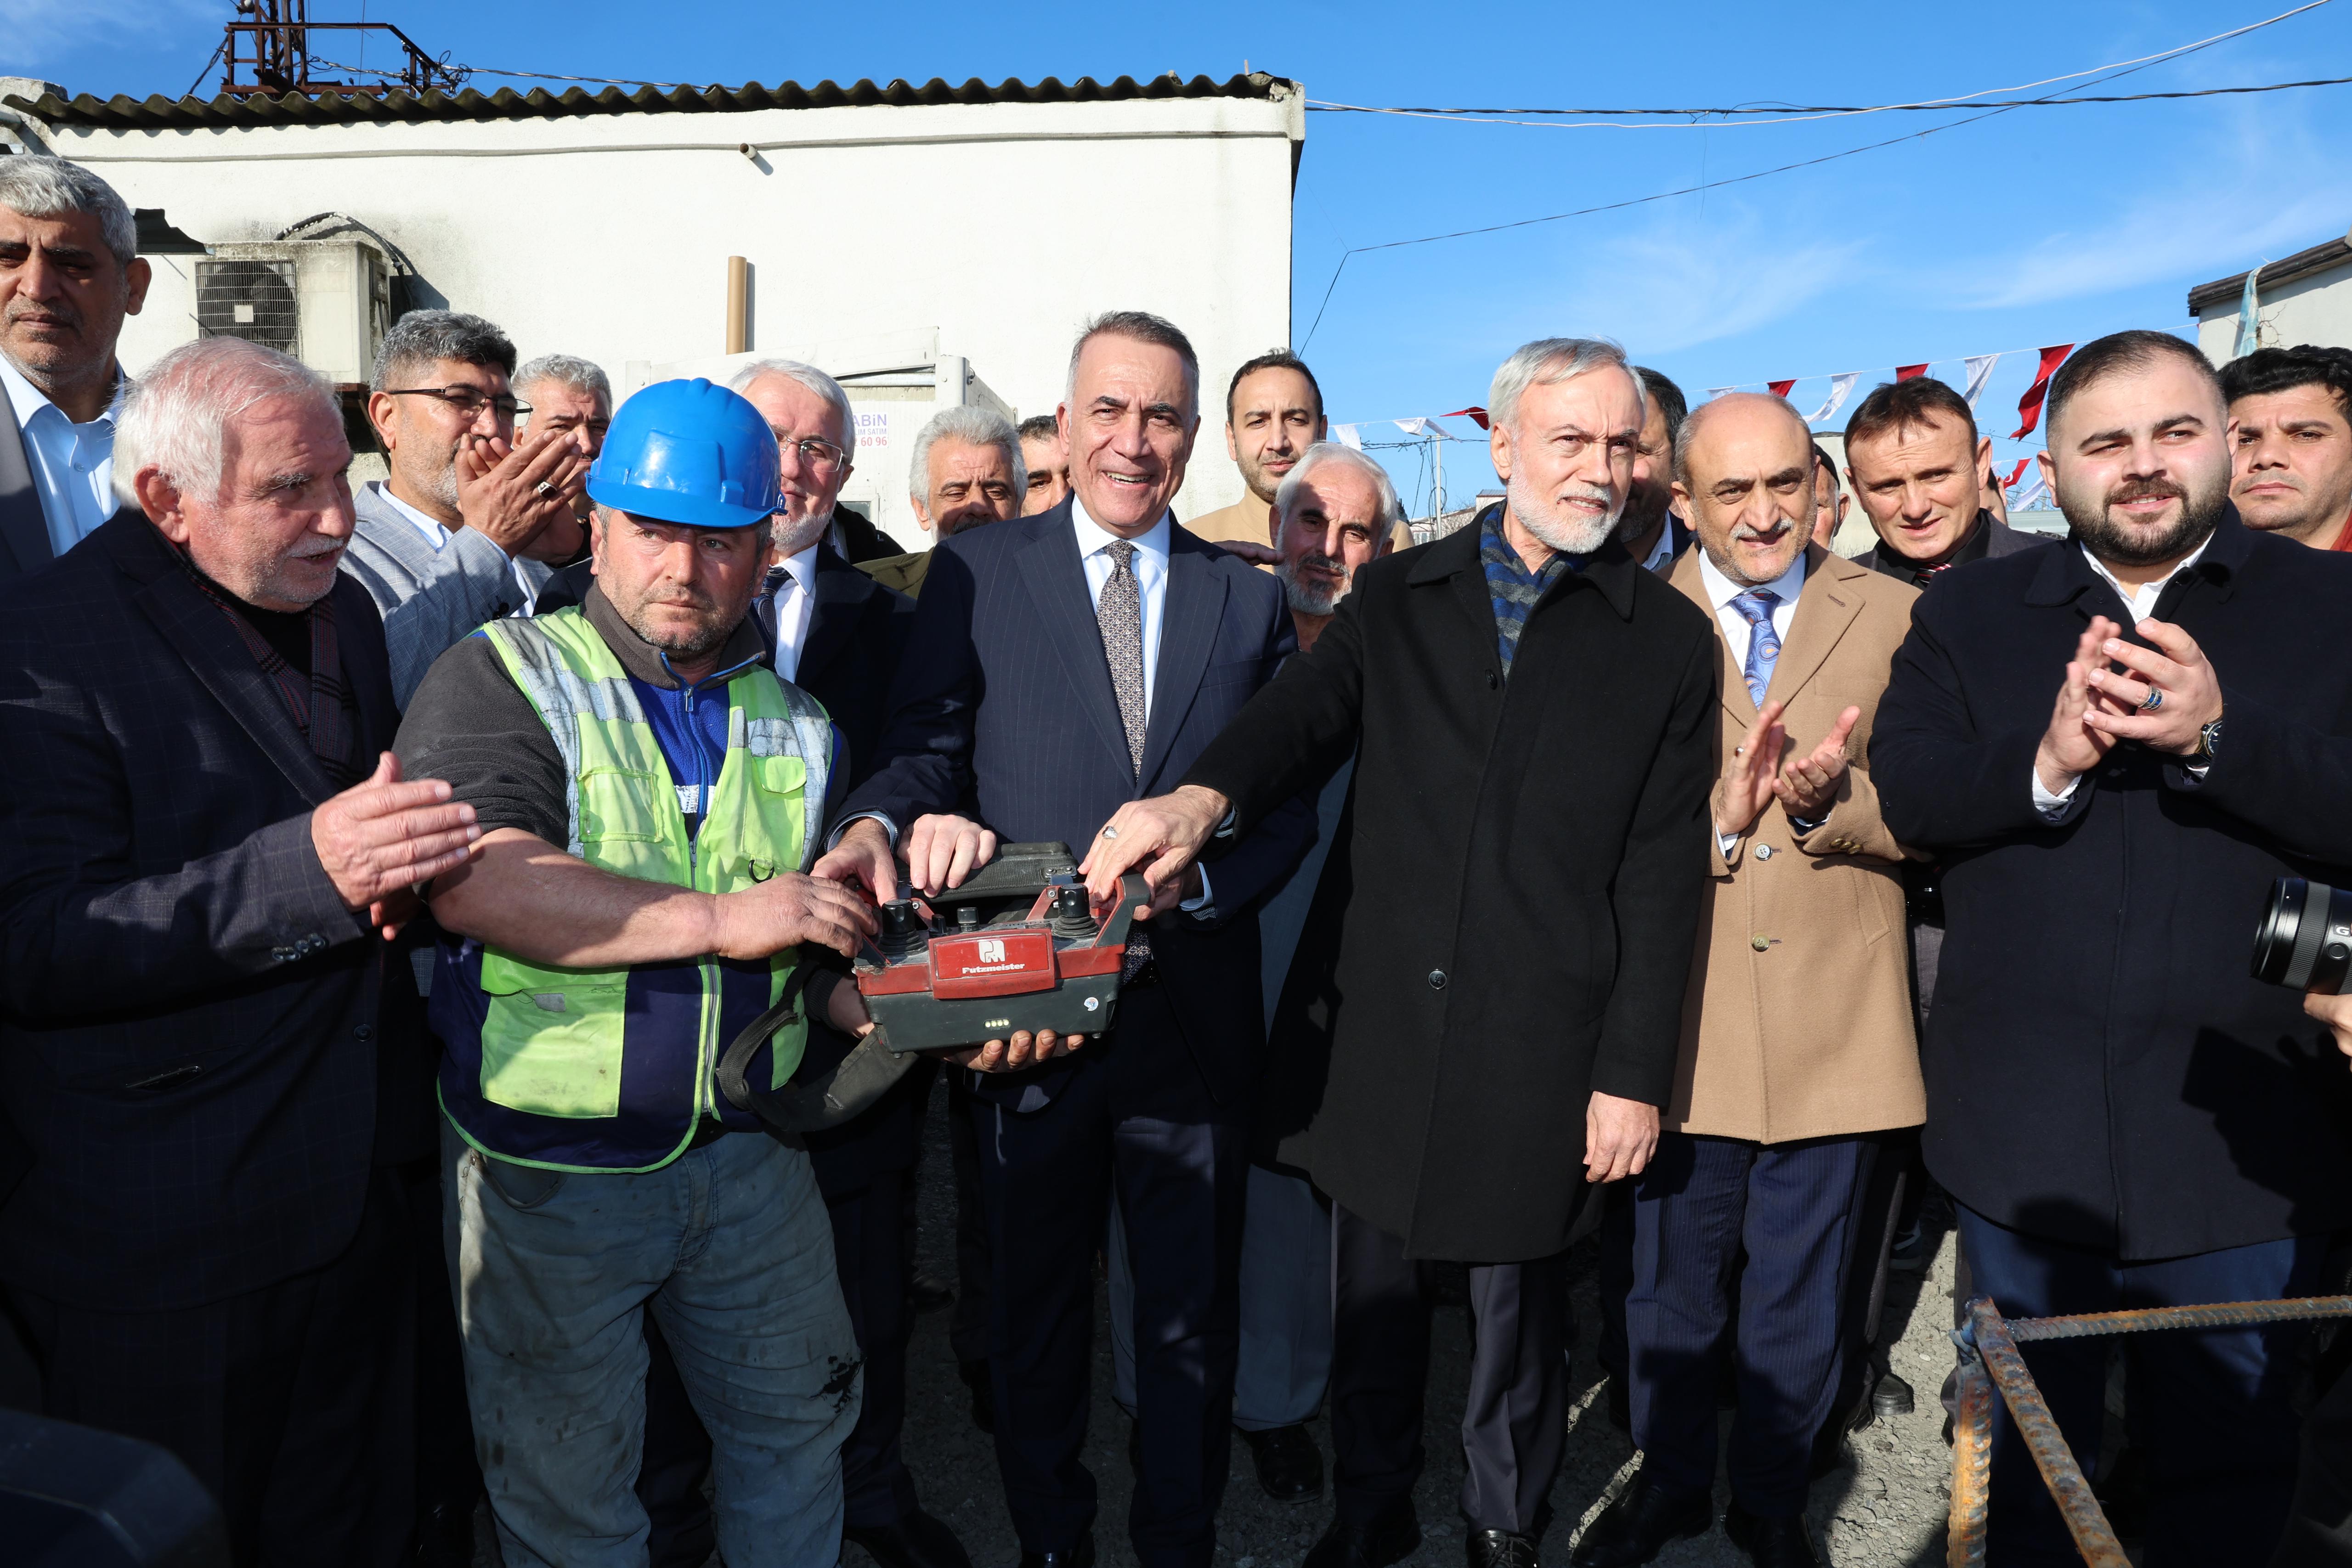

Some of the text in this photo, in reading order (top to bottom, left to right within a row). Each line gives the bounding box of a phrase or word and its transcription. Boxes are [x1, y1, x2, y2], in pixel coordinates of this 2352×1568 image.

[853, 414, 887, 427] ABiN
[861, 437, 872, 446] 60
[876, 436, 887, 446] 96
[962, 963, 1025, 974] Putzmeister
